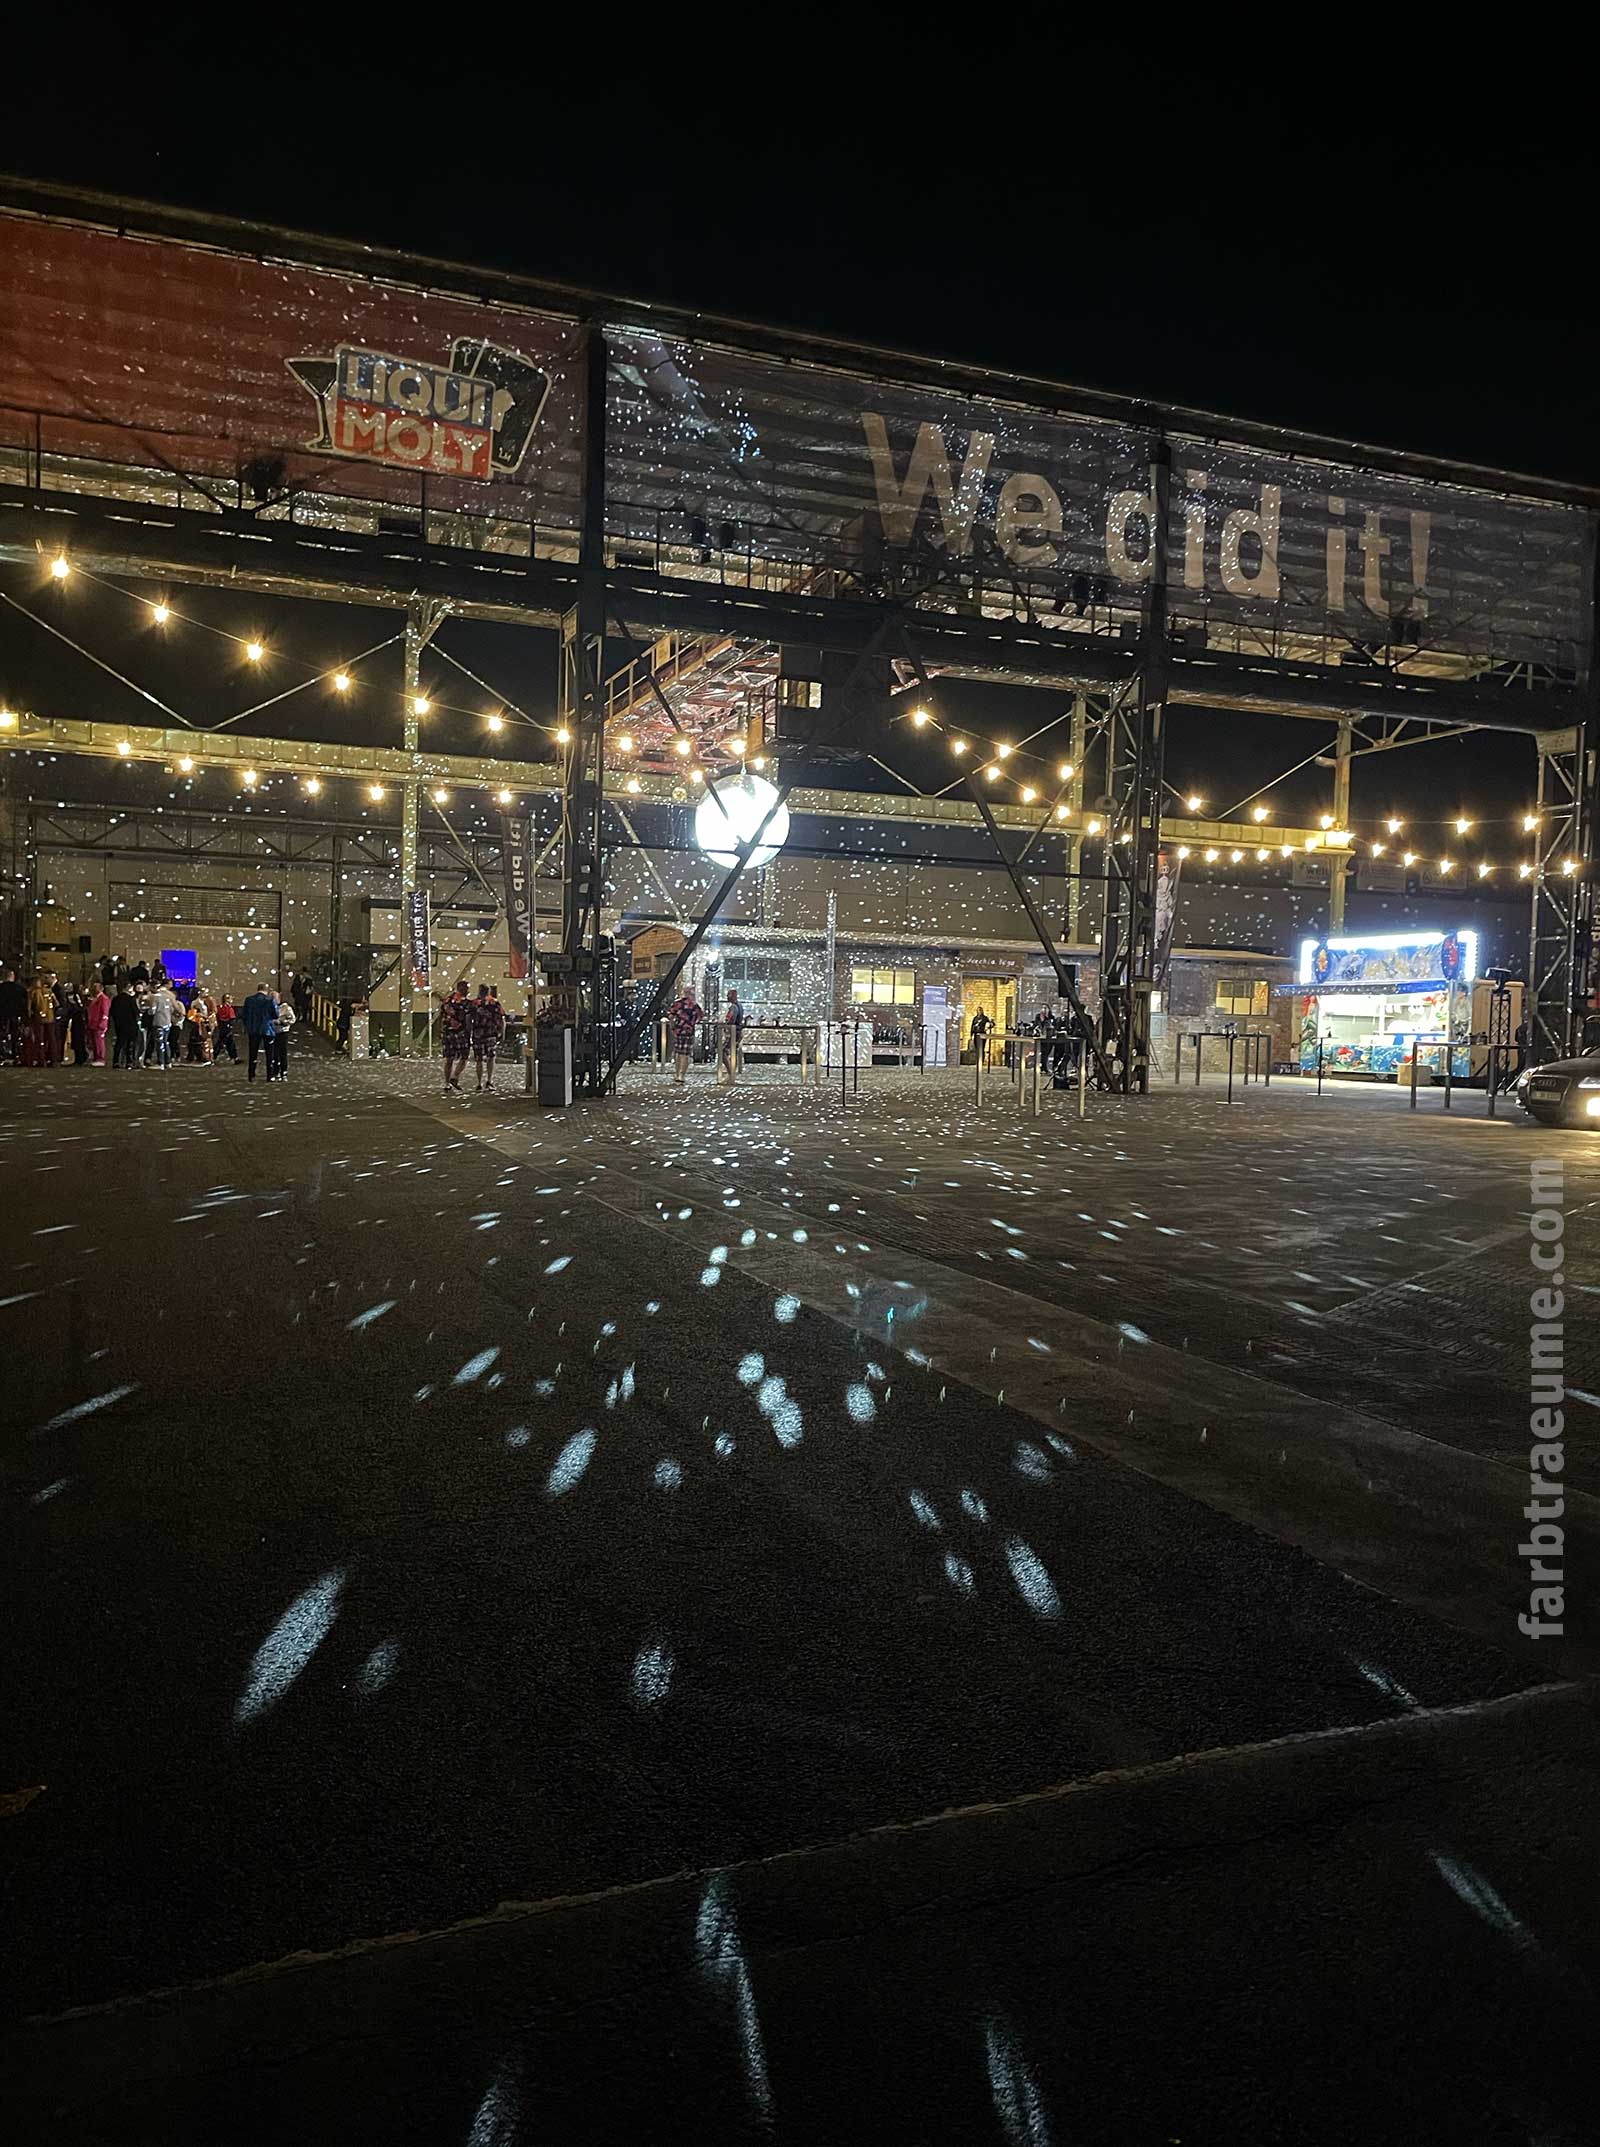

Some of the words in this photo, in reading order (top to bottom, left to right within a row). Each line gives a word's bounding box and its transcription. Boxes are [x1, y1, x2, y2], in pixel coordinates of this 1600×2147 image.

[345, 355, 487, 426] LIQUI
[343, 405, 488, 473] MOLY
[861, 411, 1064, 569] We
[1105, 464, 1282, 600] did
[1326, 497, 1432, 619] it!
